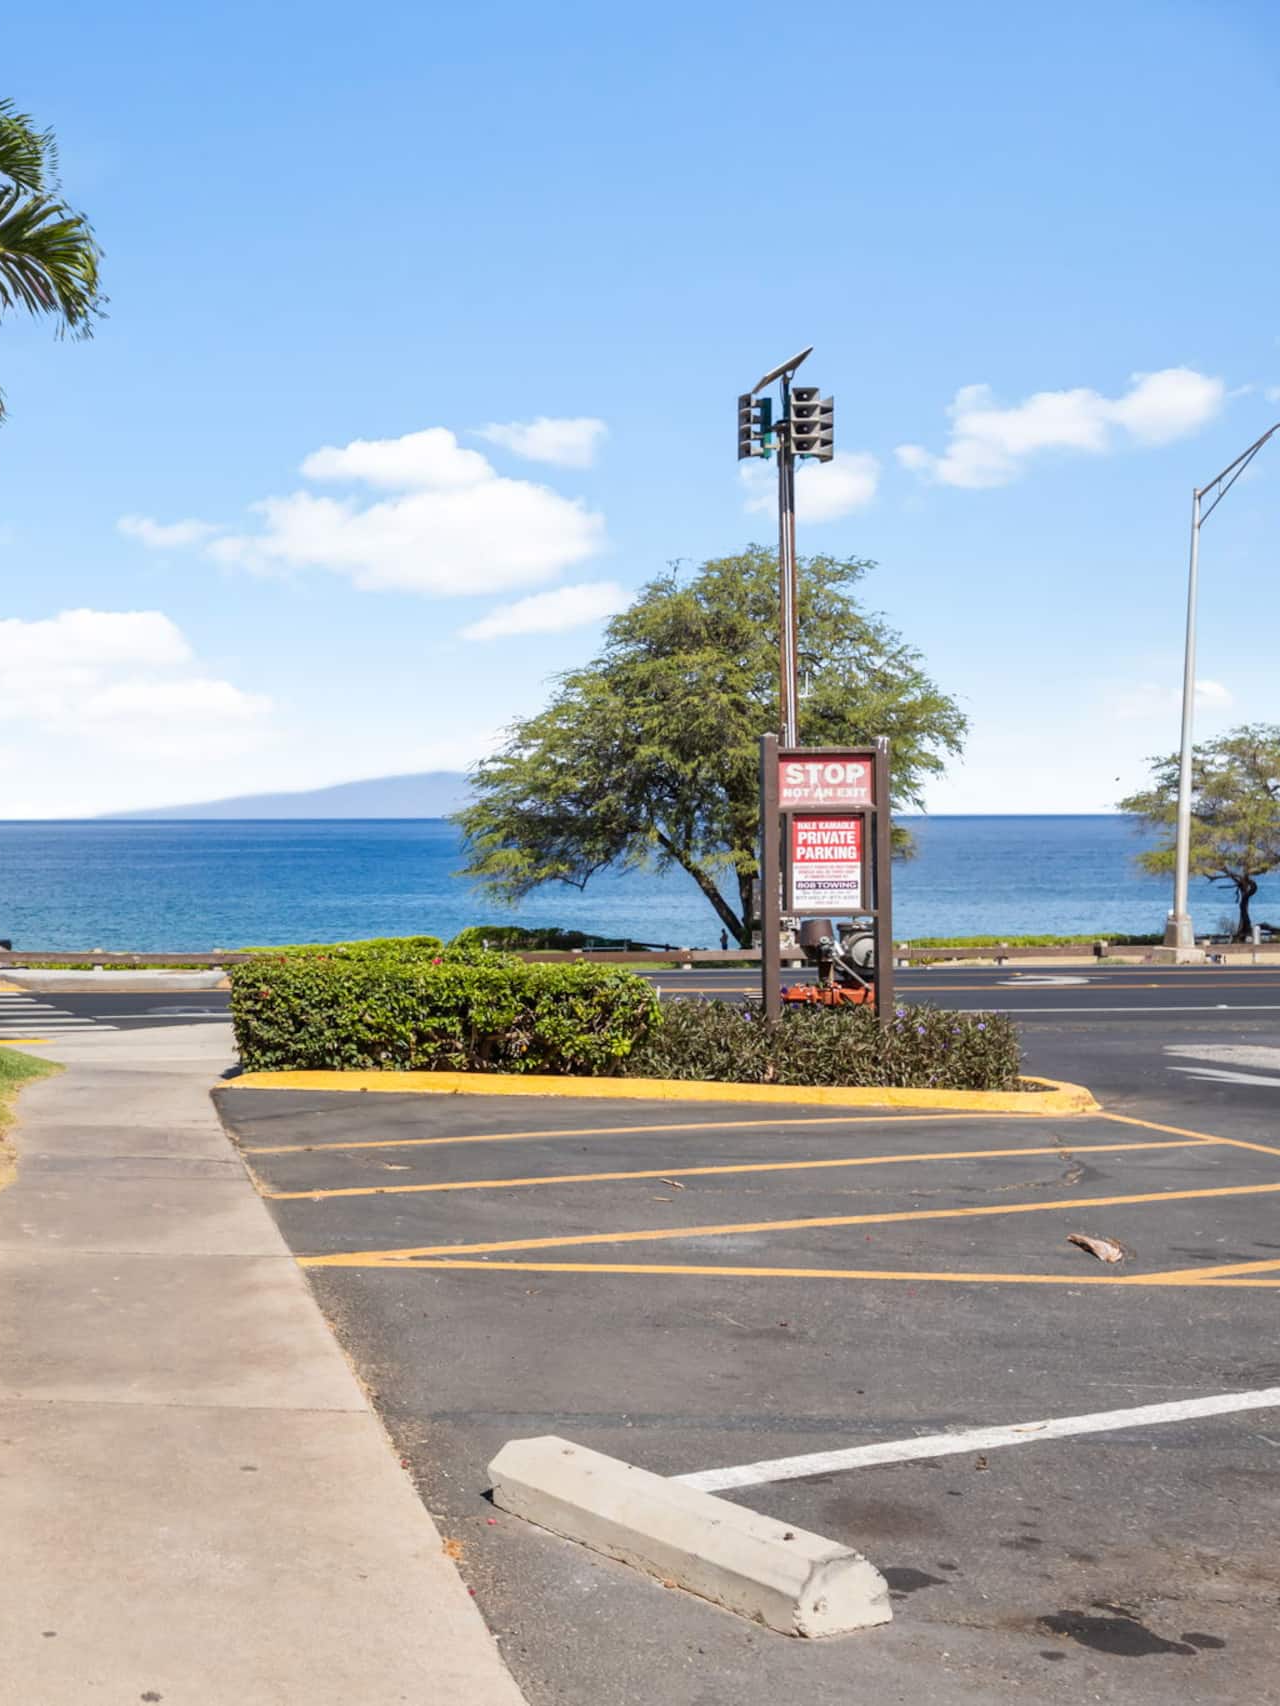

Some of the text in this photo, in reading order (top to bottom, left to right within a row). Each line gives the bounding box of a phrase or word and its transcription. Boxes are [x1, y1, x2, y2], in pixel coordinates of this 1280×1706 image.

[785, 763, 865, 784] STOP
[783, 787, 809, 798] NOT
[837, 787, 867, 798] EXIT
[798, 831, 856, 844] PRIVATE
[796, 846, 857, 859] PARKING
